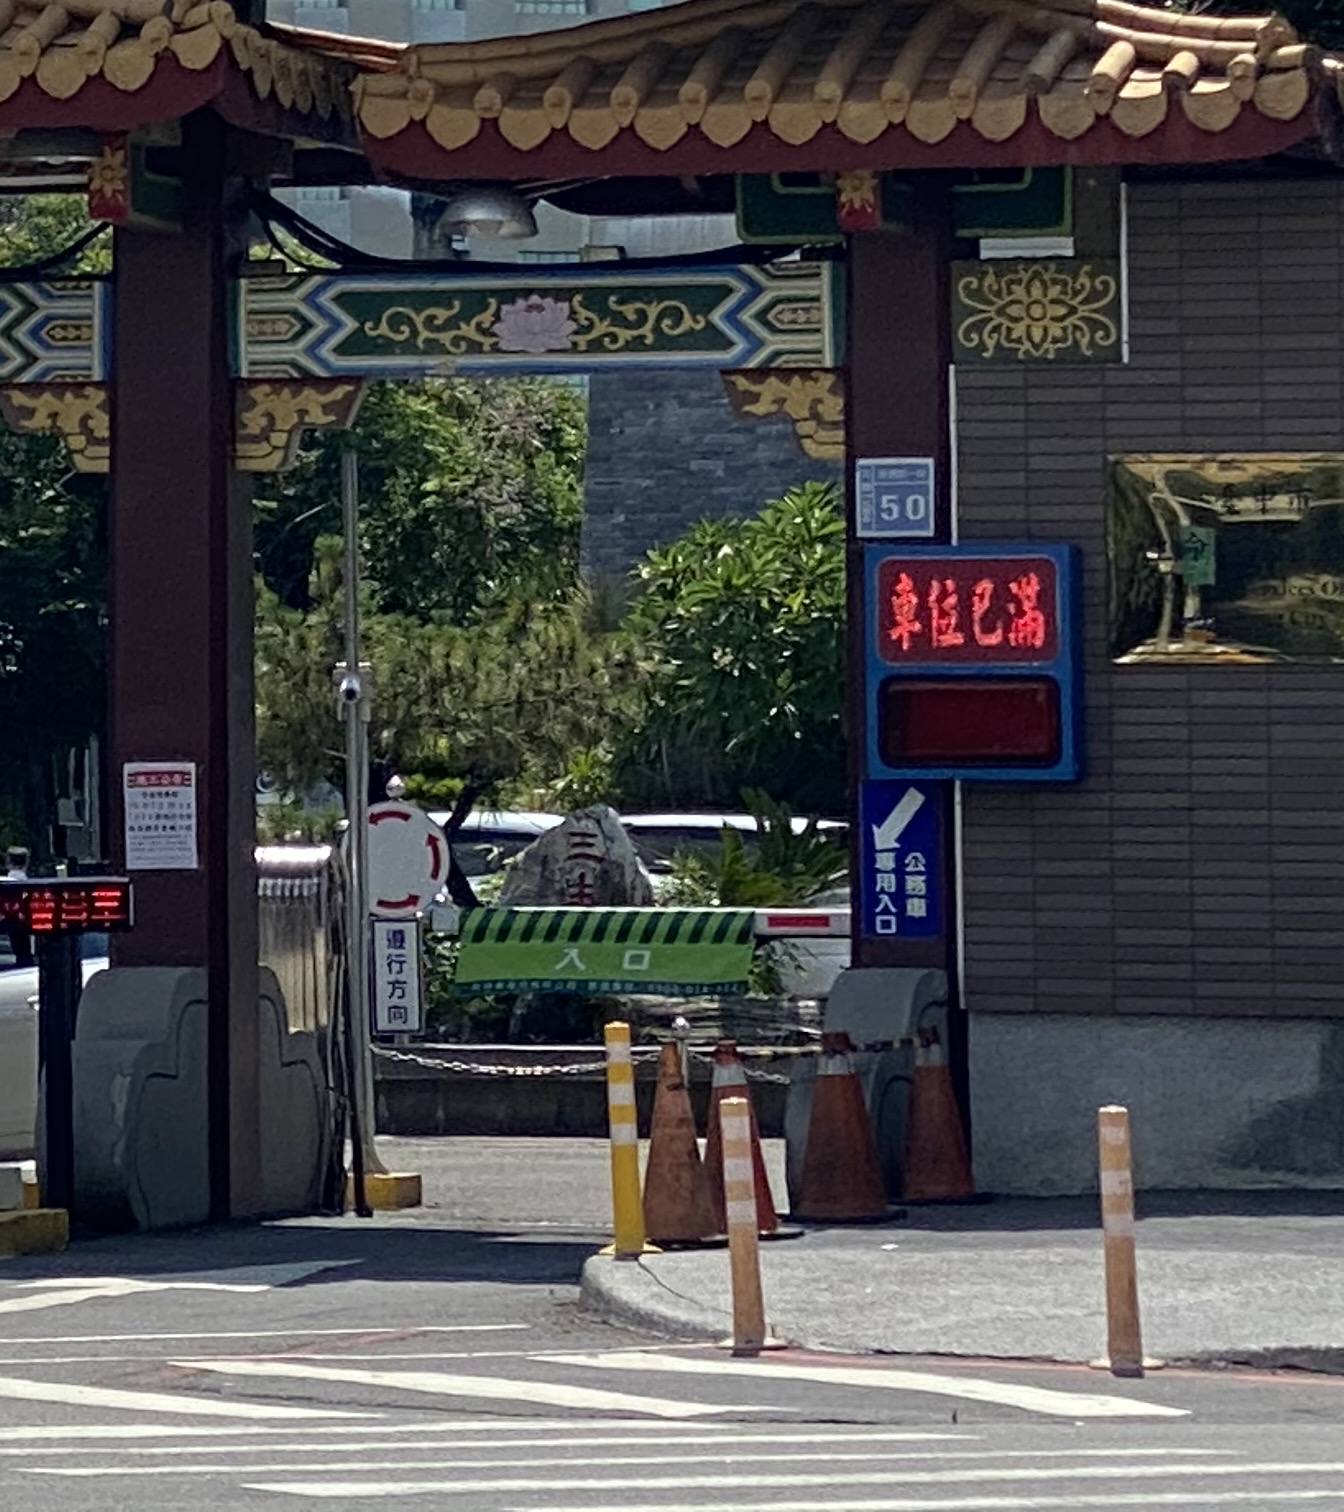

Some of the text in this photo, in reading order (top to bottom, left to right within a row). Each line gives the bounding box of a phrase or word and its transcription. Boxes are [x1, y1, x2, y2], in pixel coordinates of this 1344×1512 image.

[880, 494, 926, 521] 50
[889, 571, 1047, 651] 車位已滿
[874, 851, 898, 934] 專用入口
[386, 928, 408, 1025] 遵行方向
[555, 947, 652, 972] 入口
